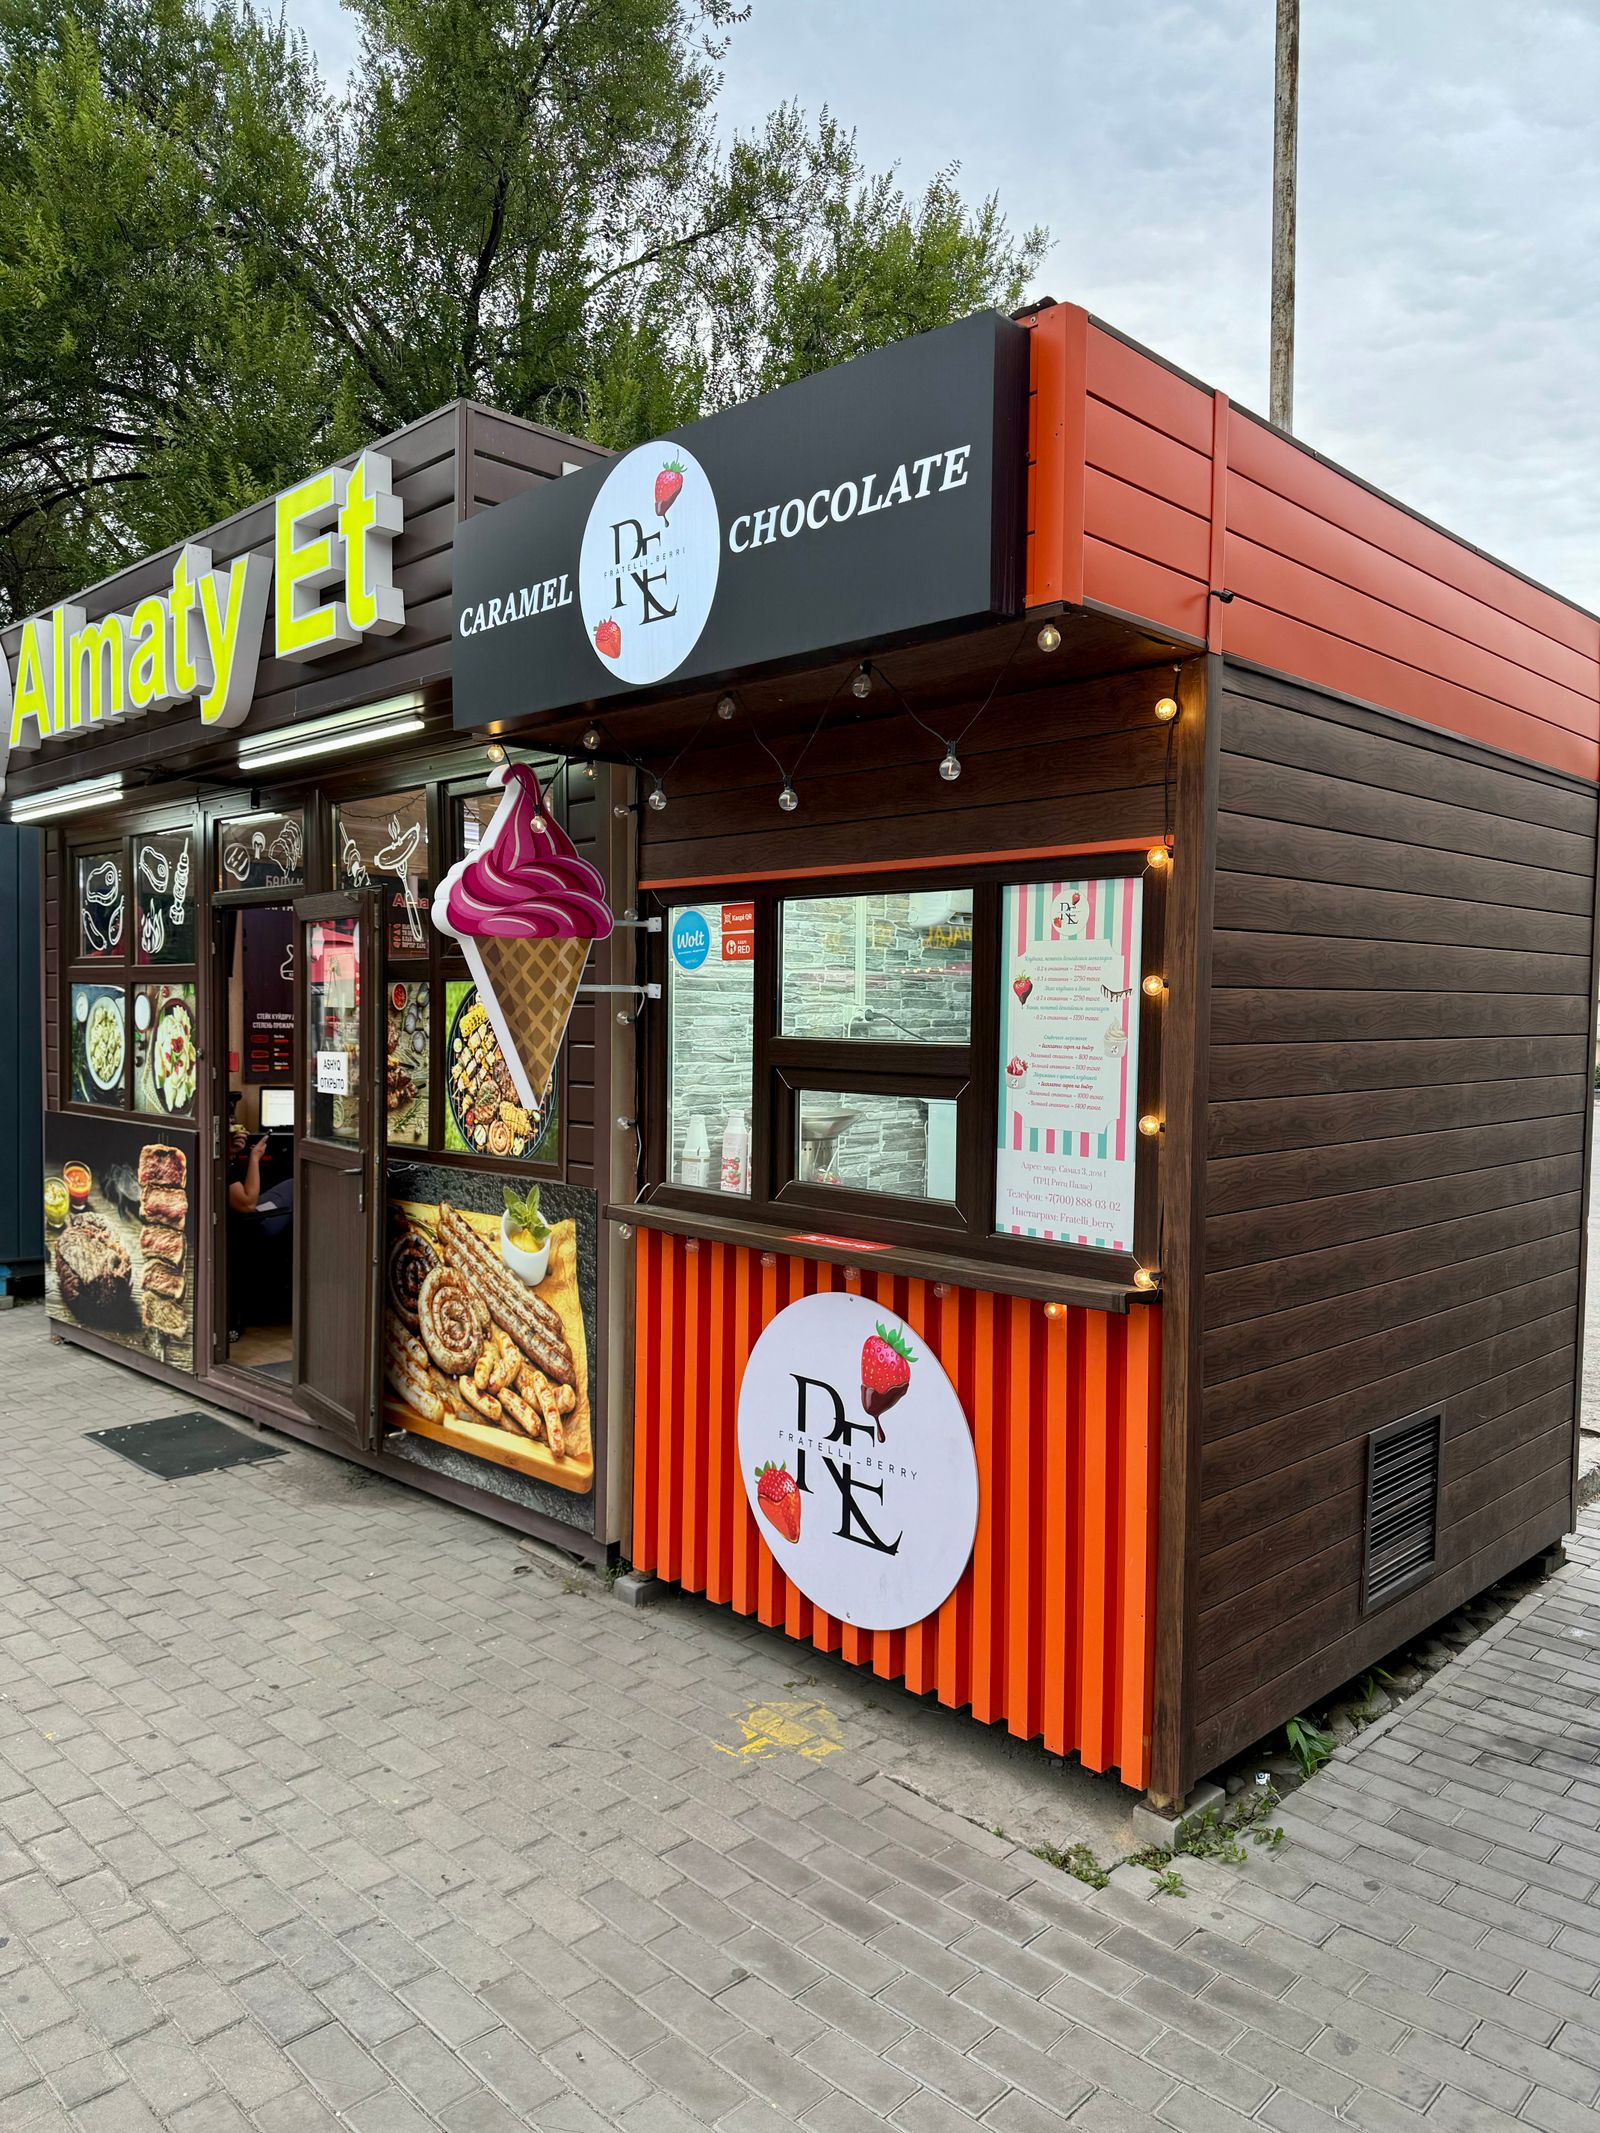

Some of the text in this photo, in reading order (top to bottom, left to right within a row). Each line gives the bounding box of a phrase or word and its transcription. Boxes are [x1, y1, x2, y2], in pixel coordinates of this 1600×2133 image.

[728, 444, 972, 554] CHOCOLATE
[8, 450, 395, 749] Almaty Et
[459, 573, 573, 638] CARAMEL
[677, 930, 705, 949] Wolt
[737, 945, 751, 955] RED
[1006, 1188, 1043, 1202] Телефон:
[778, 1430, 919, 1481] FRATELLI_BERRY
